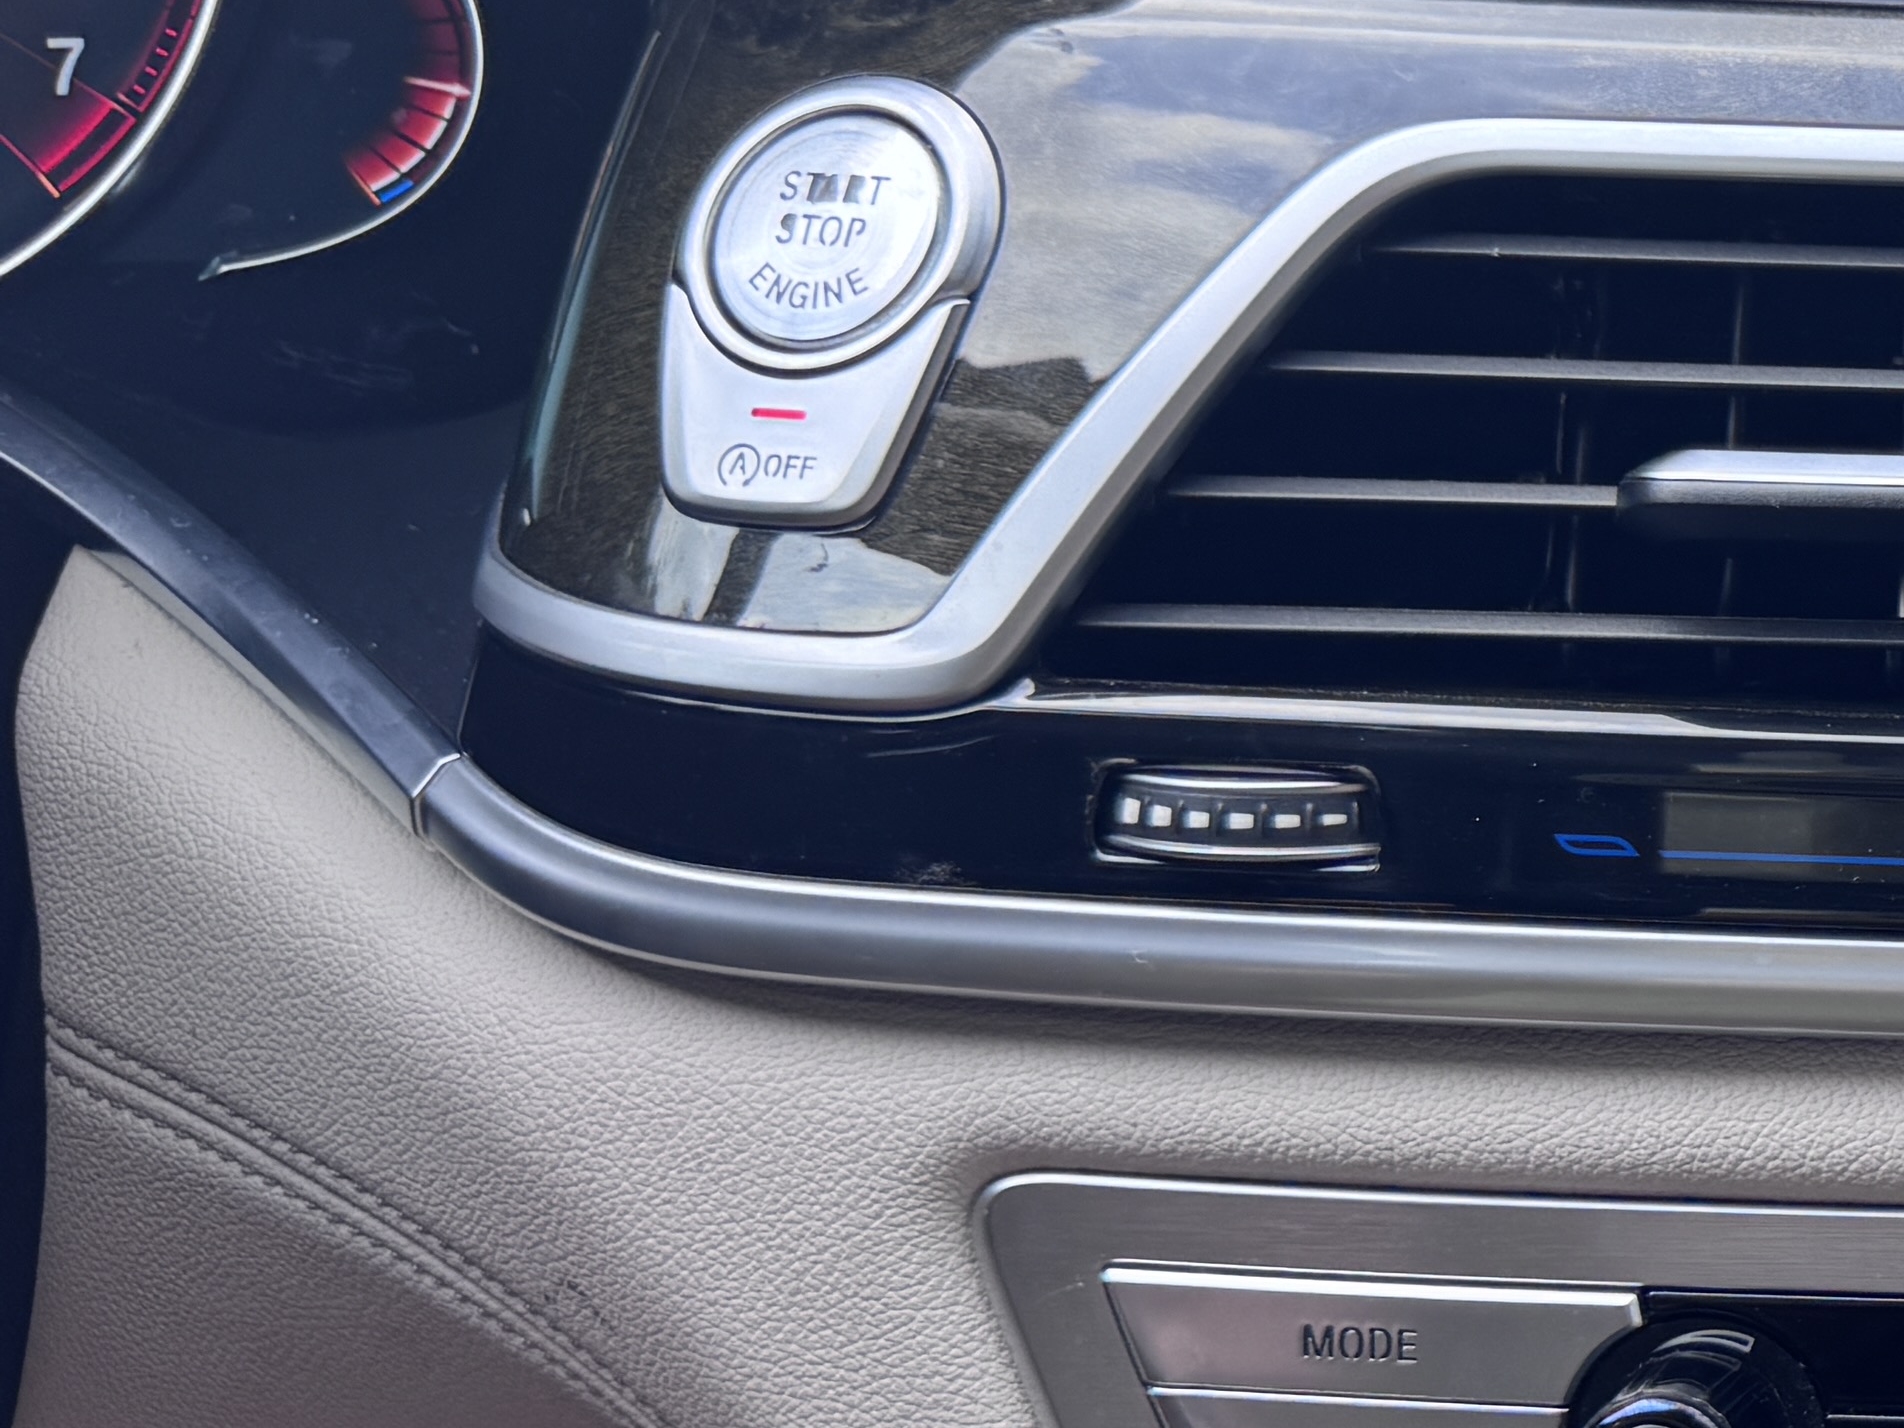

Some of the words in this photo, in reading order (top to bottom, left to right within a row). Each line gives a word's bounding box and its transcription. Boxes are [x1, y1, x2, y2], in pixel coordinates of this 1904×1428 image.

[46, 37, 85, 96] 7
[779, 170, 891, 205] START
[775, 213, 866, 247] STOP
[748, 262, 870, 309] ENGINE
[763, 455, 817, 480] OFF
[1301, 1324, 1418, 1364] MODE
